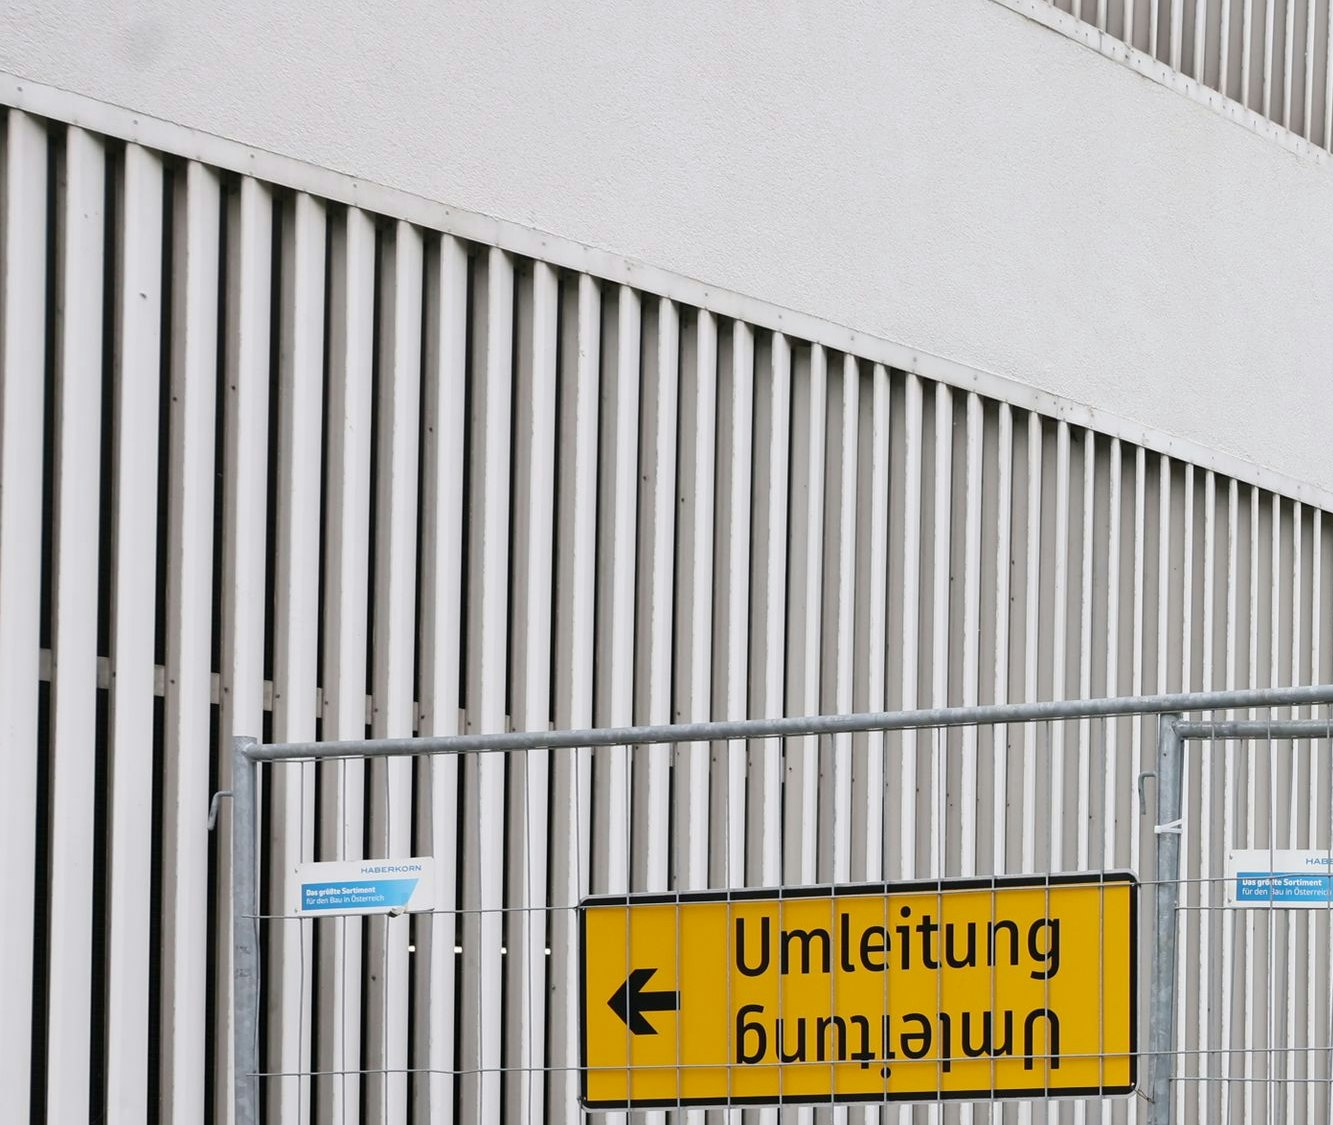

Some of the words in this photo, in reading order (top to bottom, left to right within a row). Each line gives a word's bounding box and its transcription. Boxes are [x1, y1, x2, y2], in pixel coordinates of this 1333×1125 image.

[360, 864, 422, 874] HABERKORN
[1284, 879, 1322, 887] Sortiment
[319, 888, 341, 898] größte
[342, 886, 376, 895] Sortiment
[1242, 888, 1253, 896] für
[1254, 888, 1268, 896] den
[1285, 888, 1293, 896] in
[351, 894, 384, 902] Österreich
[735, 905, 1061, 980] Umleitung
[735, 1003, 1061, 1080] Umleitung
